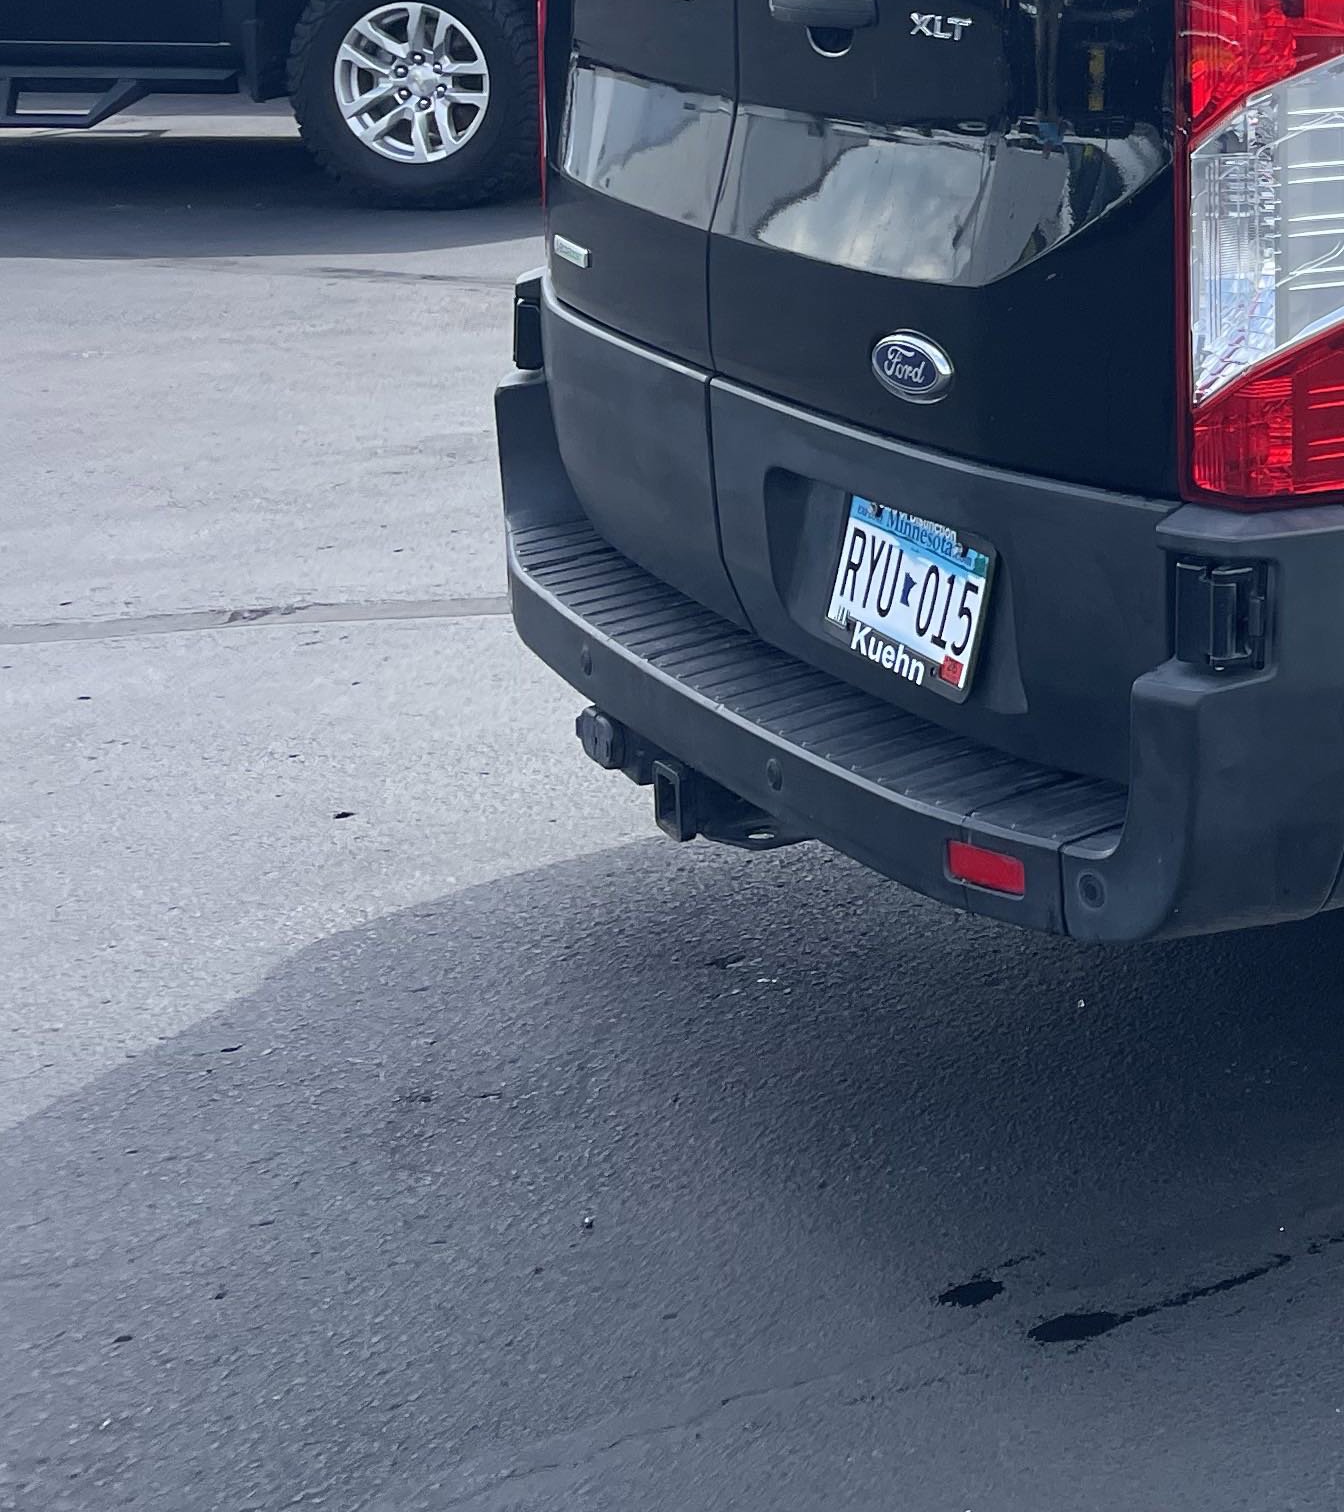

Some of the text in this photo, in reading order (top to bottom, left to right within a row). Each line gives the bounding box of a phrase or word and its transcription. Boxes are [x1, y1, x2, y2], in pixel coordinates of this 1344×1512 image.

[910, 12, 972, 40] XLT
[884, 346, 926, 384] Ford
[886, 510, 953, 555] Minnesota
[840, 527, 979, 656] RYU 015
[850, 621, 925, 686] Kuehn
